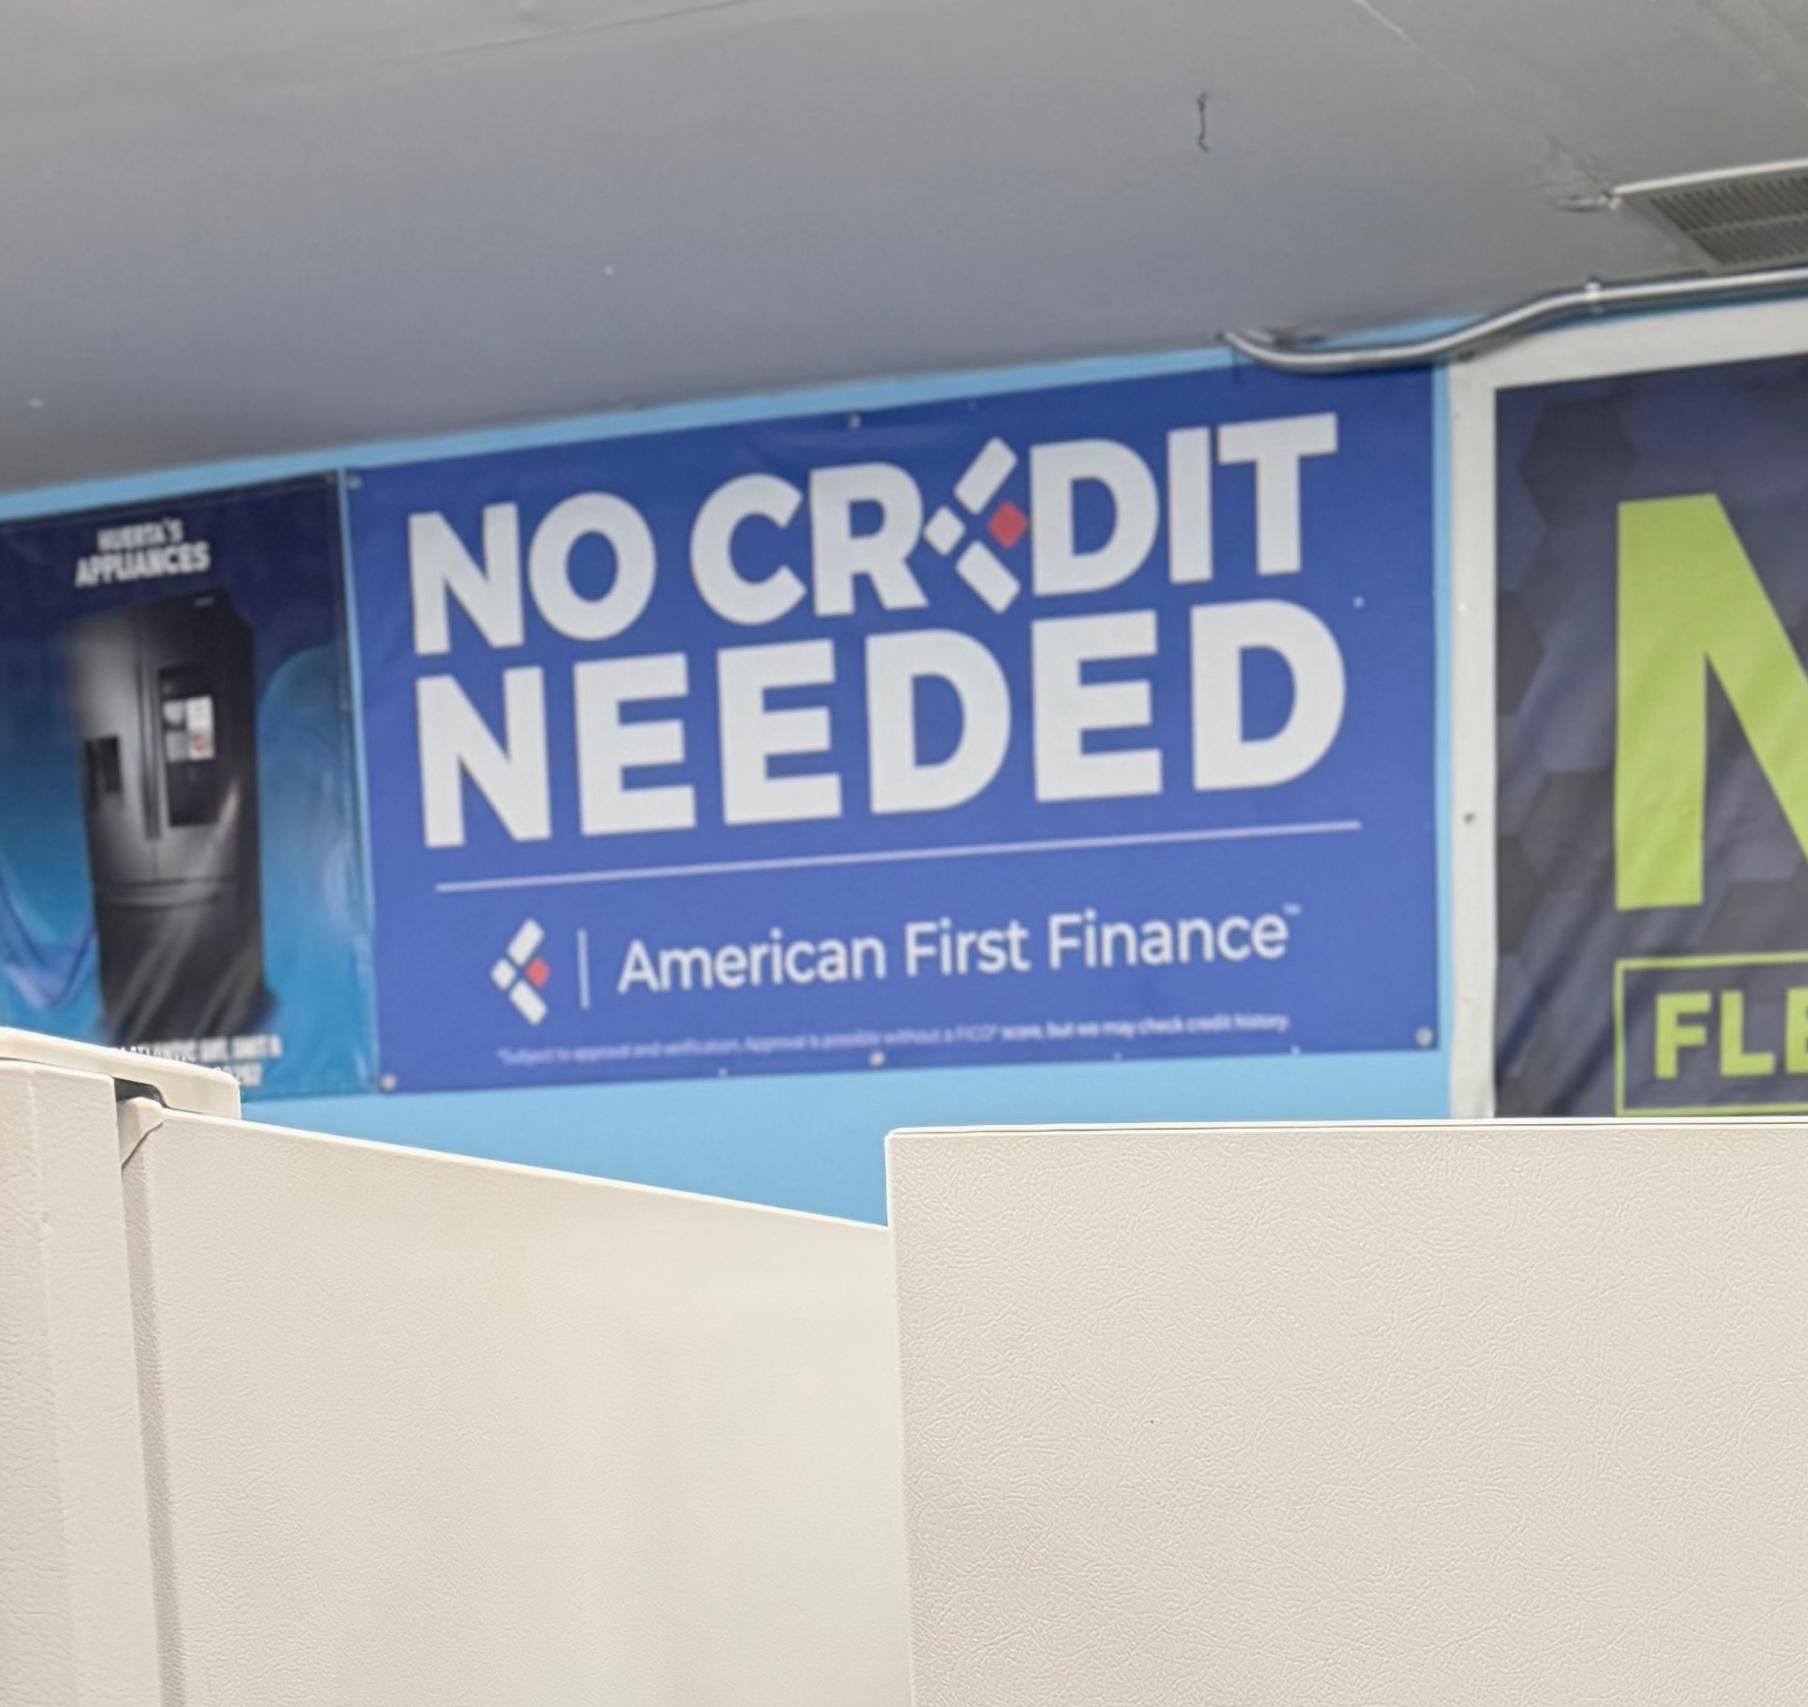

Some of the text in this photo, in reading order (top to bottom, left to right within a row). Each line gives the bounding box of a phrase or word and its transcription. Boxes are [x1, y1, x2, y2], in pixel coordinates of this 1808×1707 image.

[409, 492, 656, 656] NO
[416, 600, 1346, 849] NEEDED
[617, 926, 887, 995] American
[905, 915, 1032, 976] First
